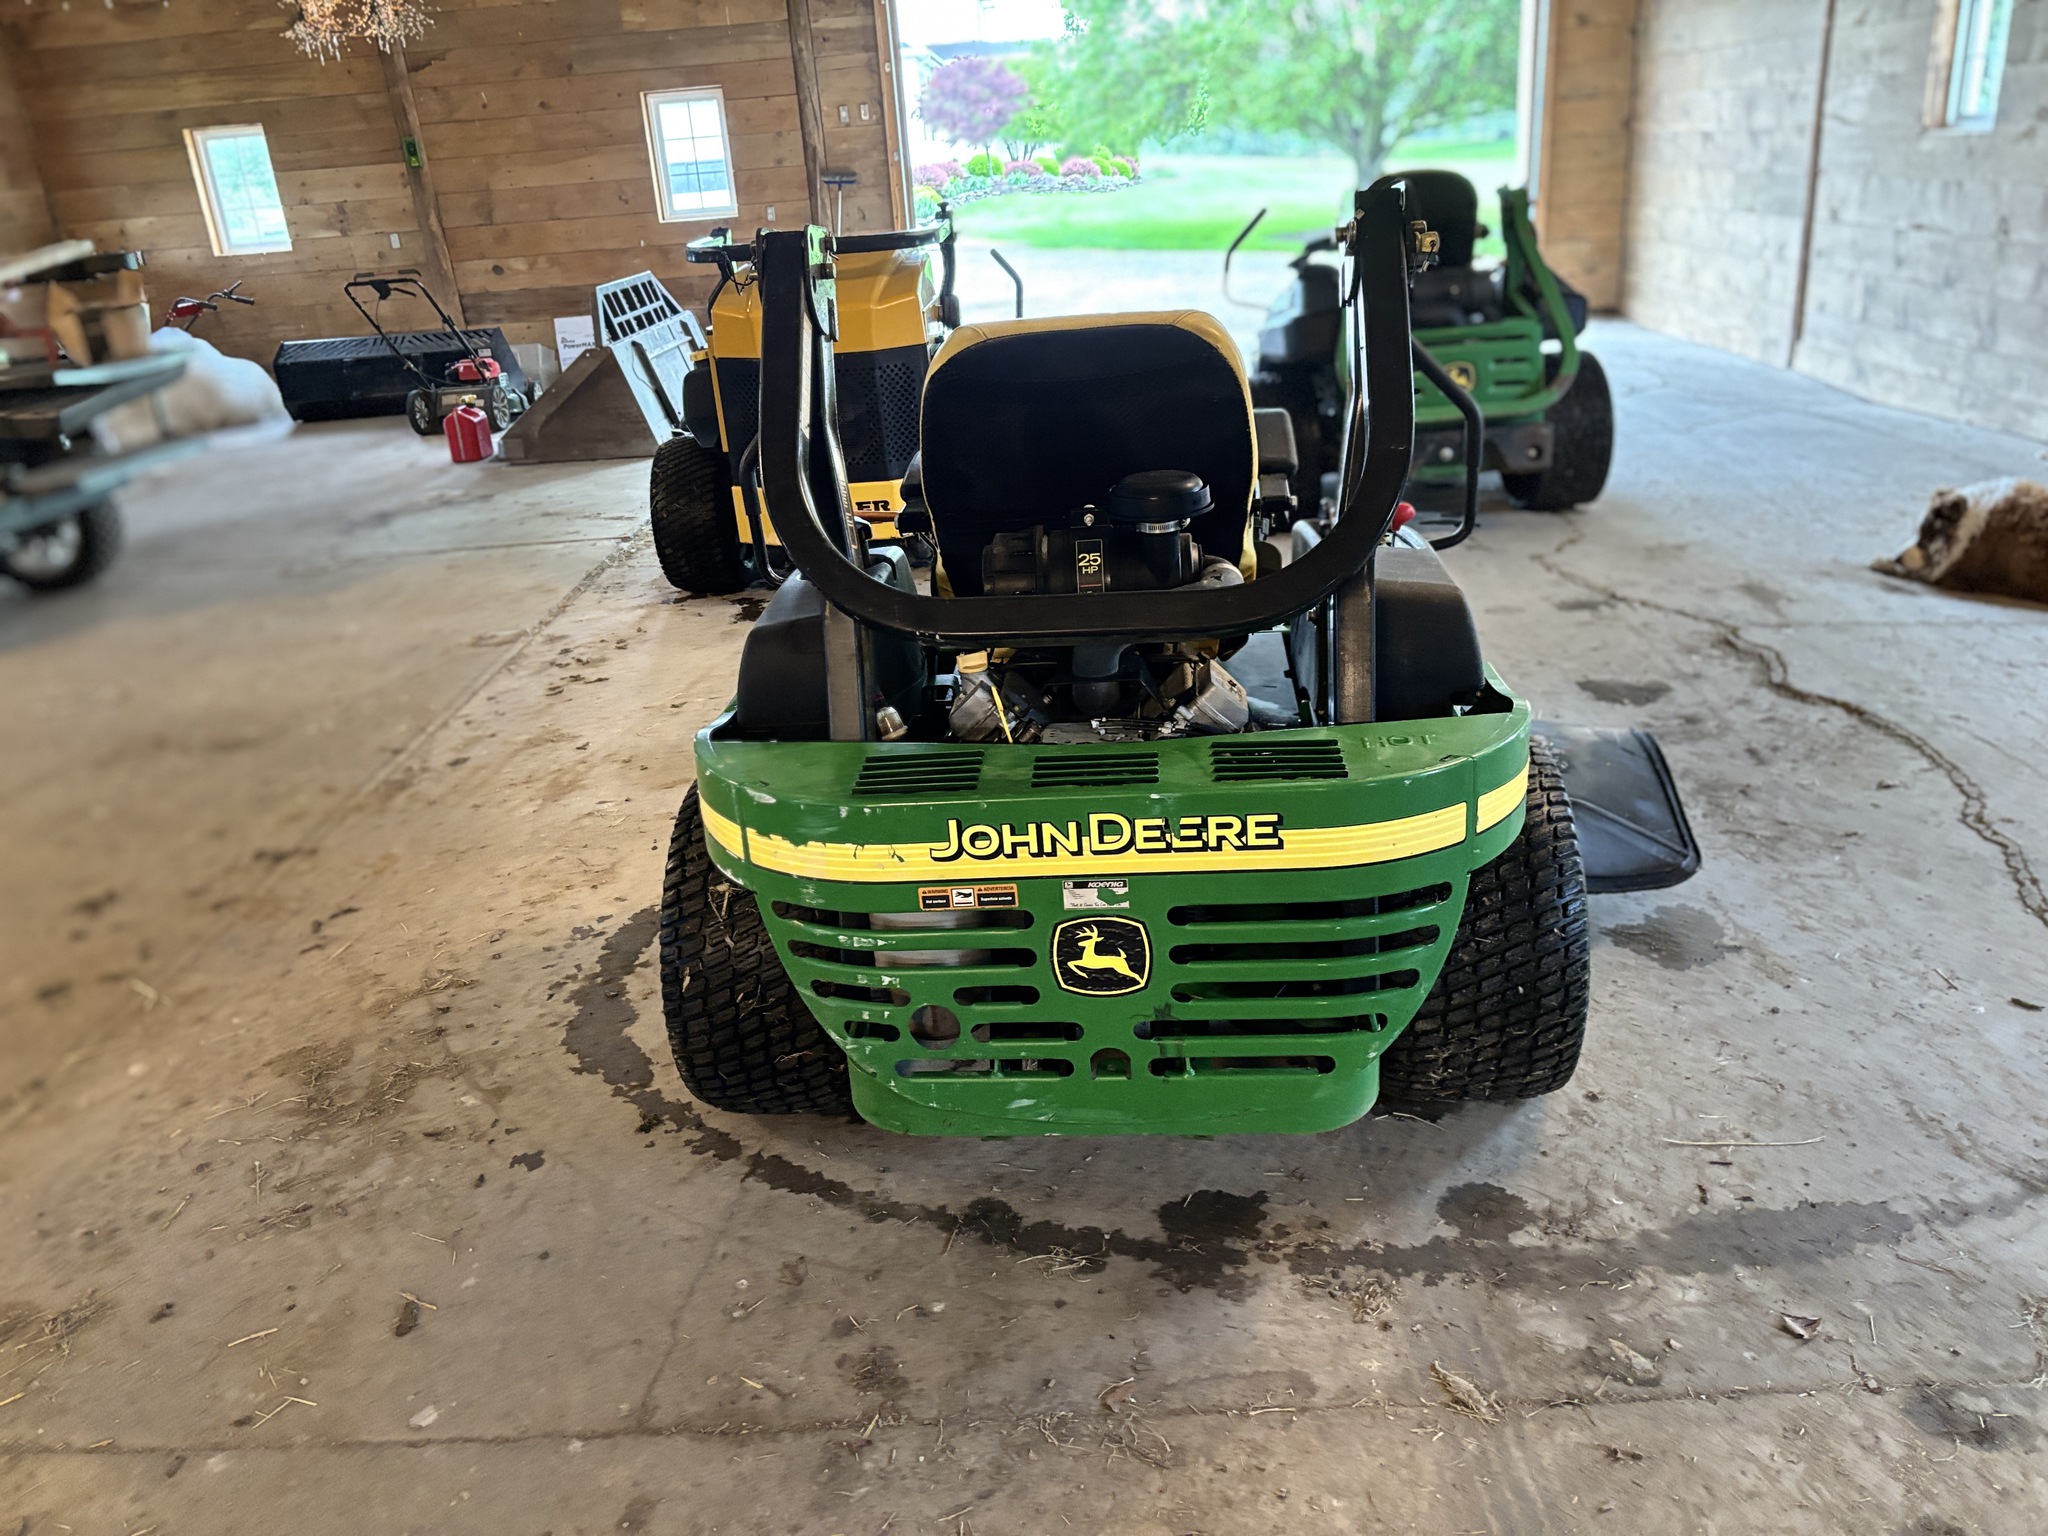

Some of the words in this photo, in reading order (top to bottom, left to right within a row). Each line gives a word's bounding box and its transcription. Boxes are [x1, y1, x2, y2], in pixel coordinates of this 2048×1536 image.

[1078, 552, 1101, 567] 25
[1082, 565, 1099, 575] HP
[1361, 733, 1437, 749] HOT
[929, 817, 1084, 863] JOHN
[1087, 811, 1285, 855] DEERE
